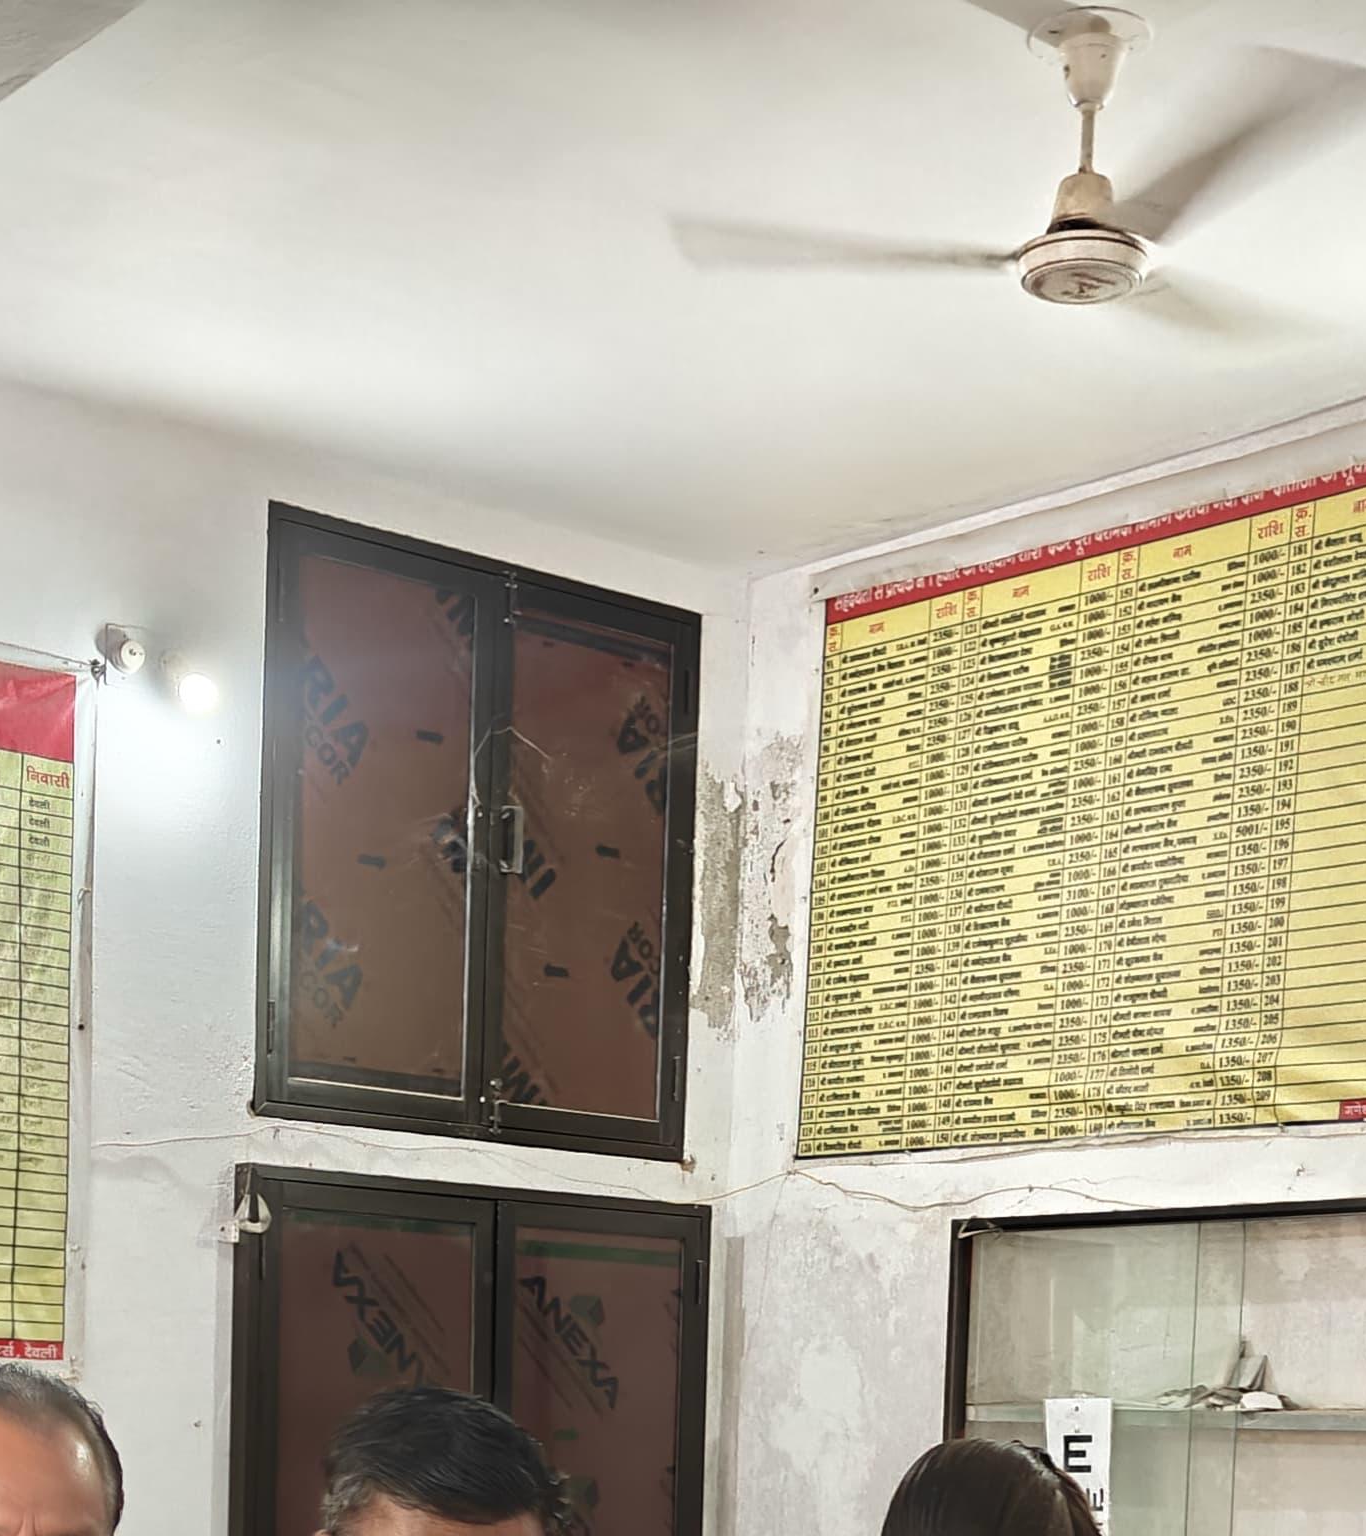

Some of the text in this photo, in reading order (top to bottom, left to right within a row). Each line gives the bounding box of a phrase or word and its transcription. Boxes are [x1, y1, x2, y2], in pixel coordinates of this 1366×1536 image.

[1257, 520, 1285, 541] राशि
[1087, 563, 1112, 583] राशि
[25, 765, 70, 789] निवासी
[1063, 1435, 1092, 1473] E
